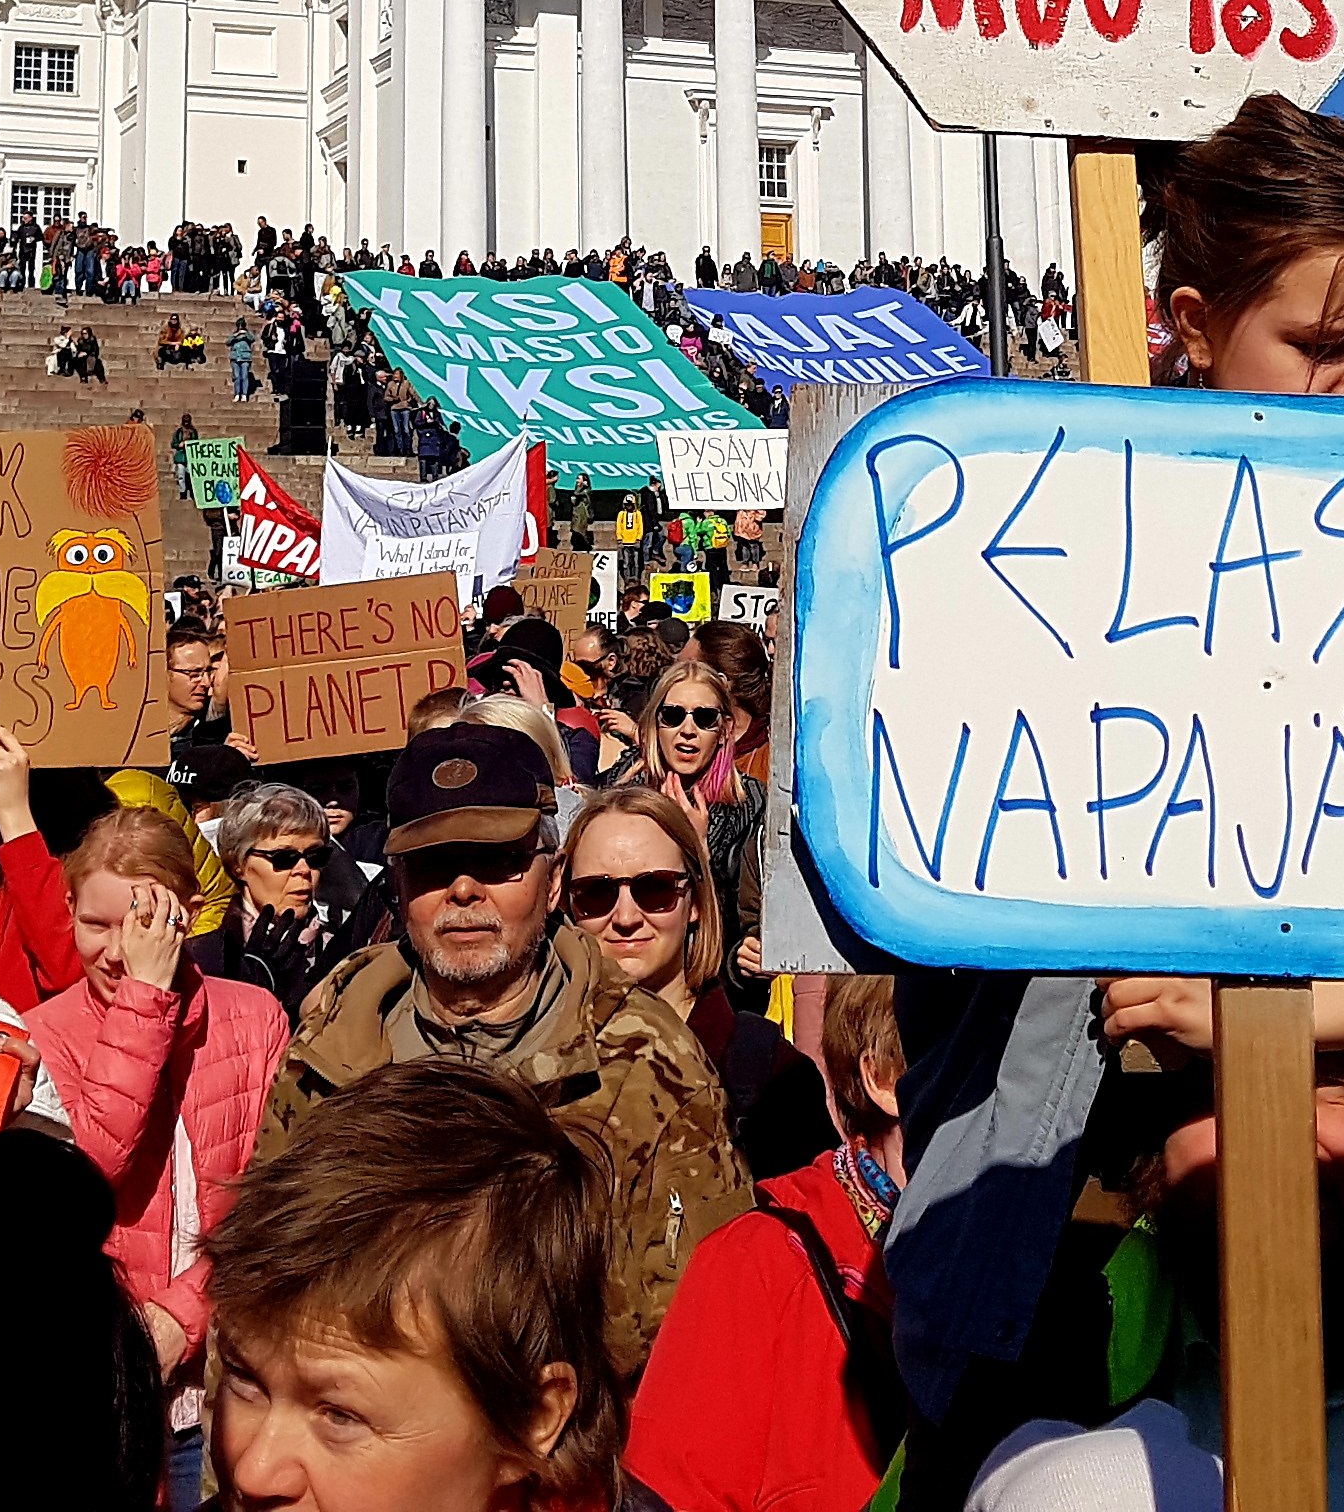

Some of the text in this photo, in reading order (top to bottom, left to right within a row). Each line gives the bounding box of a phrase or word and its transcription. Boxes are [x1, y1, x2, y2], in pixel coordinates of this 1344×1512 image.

[345, 275, 620, 333] YKSI
[373, 313, 653, 364] ILMASTO
[393, 348, 709, 421] YKSI
[187, 442, 223, 458] THERE
[191, 463, 206, 477] NO
[672, 472, 784, 502] HELSINKI
[228, 571, 245, 580] GO
[549, 584, 577, 607] ARE
[235, 596, 458, 659] THERE'S NO
[244, 662, 412, 745] PLANET
